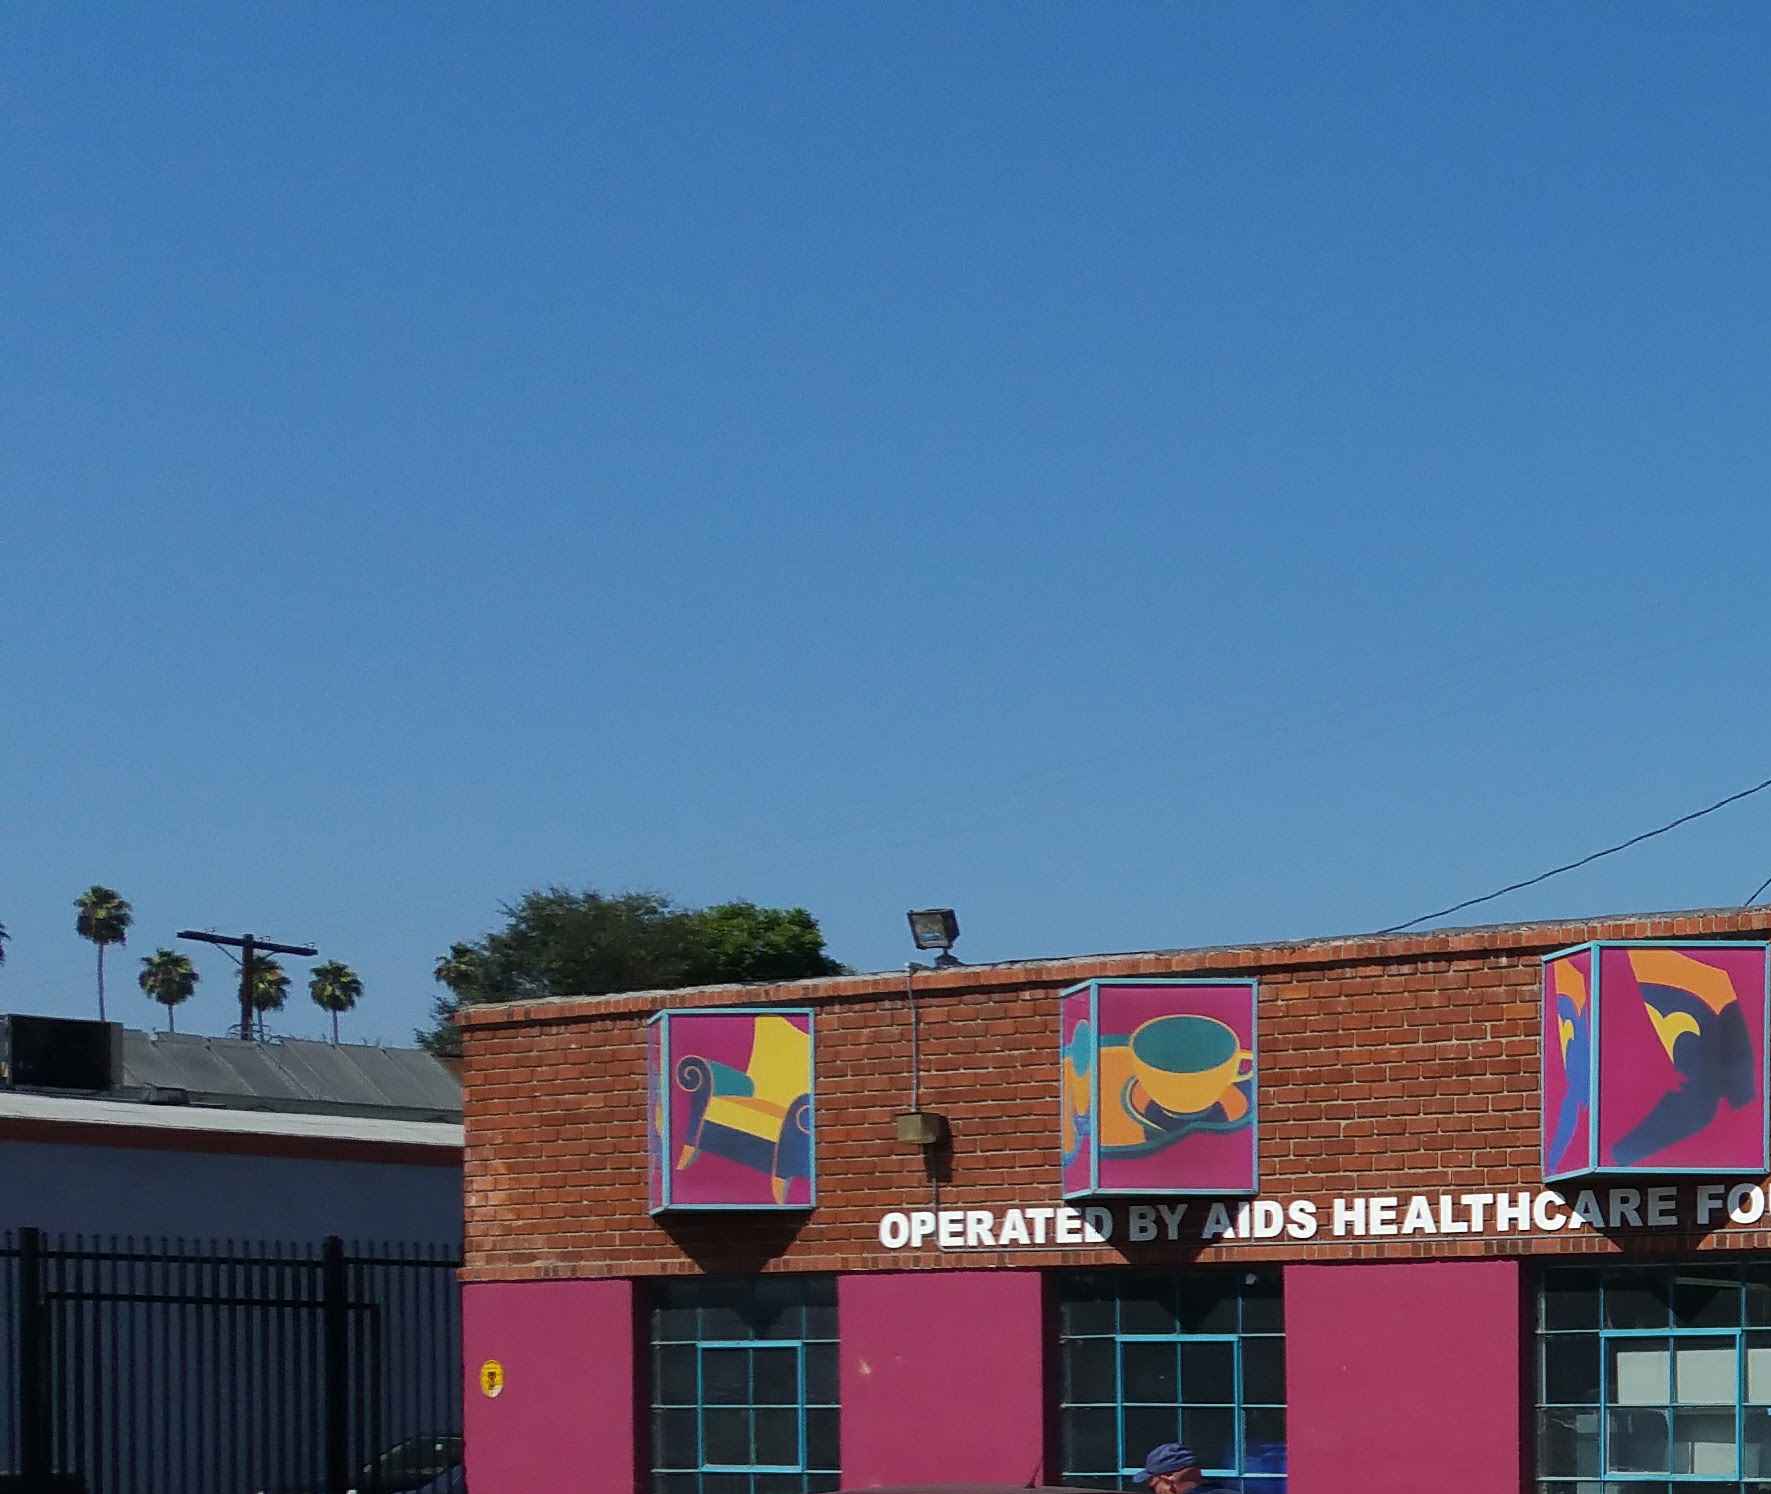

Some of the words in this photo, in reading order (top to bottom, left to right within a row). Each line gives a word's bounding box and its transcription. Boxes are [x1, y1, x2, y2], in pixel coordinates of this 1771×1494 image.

[879, 1205, 1114, 1249] OPERATED
[1127, 1203, 1188, 1242] BY
[1200, 1199, 1318, 1239] AIDS
[1332, 1186, 1680, 1237] HEALTHCARE
